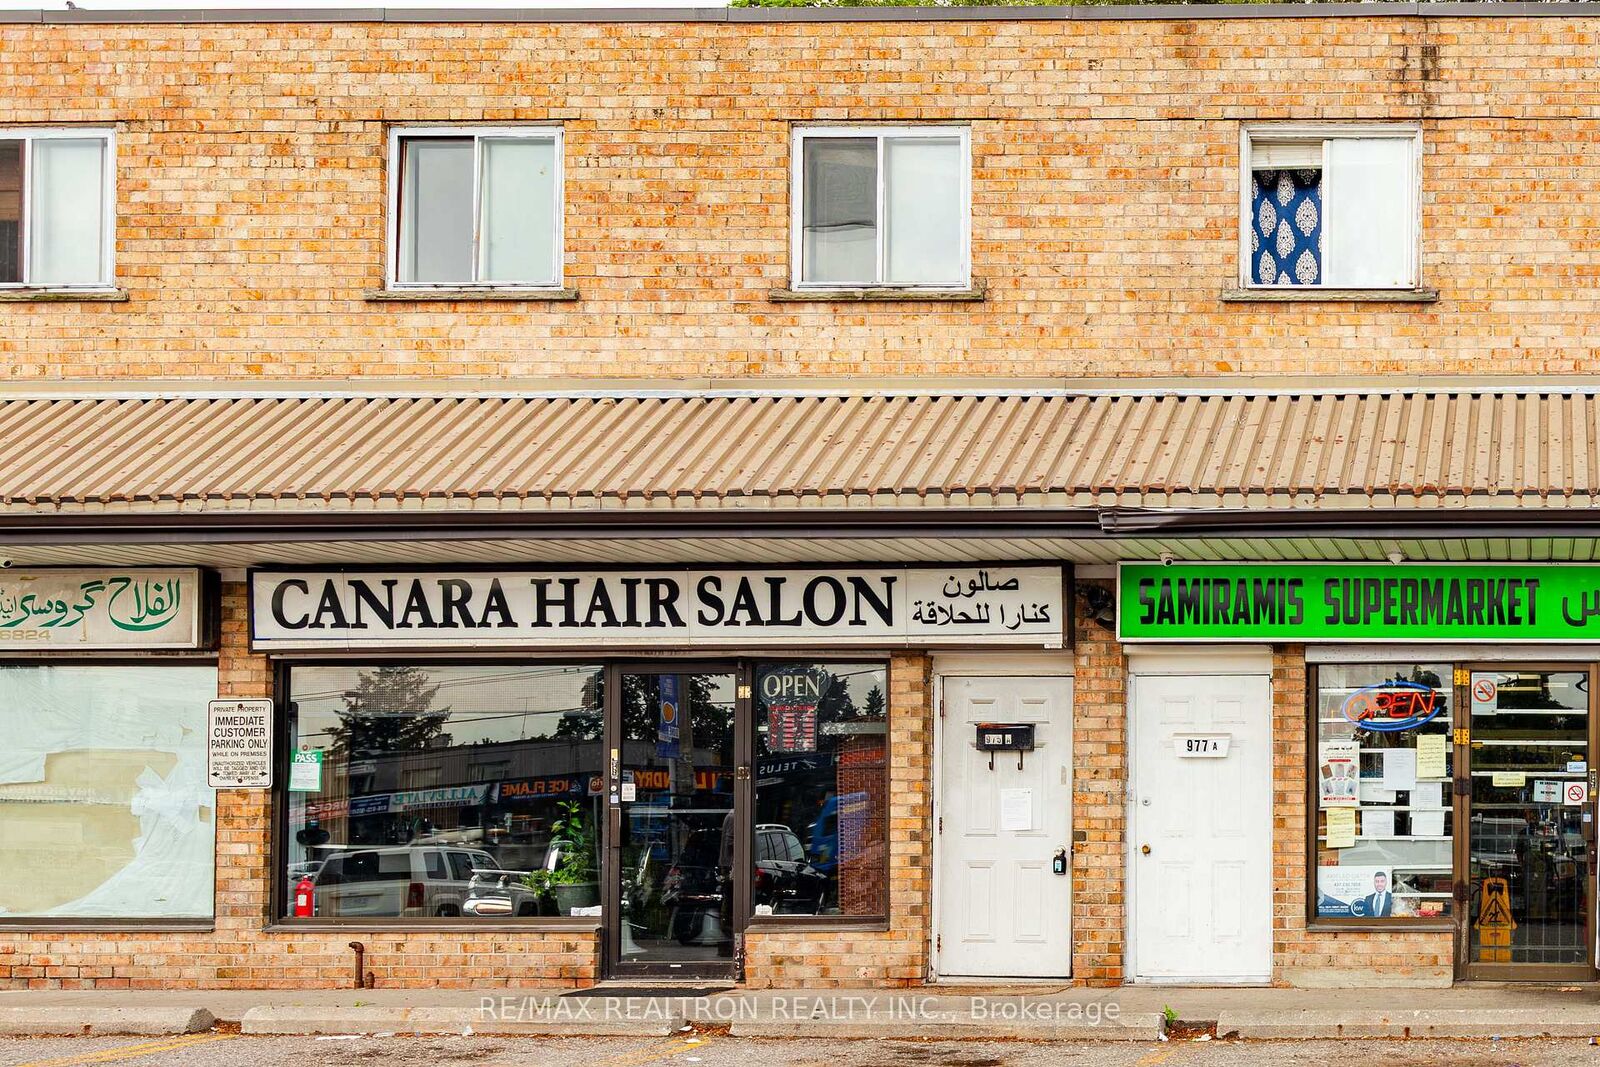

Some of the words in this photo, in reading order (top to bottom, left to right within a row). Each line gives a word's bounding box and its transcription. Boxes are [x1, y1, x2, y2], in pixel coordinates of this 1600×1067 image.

[943, 570, 1019, 598] صالون
[108, 576, 181, 631] الفلاح
[271, 578, 518, 630] CANARA
[531, 577, 687, 628] HAIR
[697, 576, 897, 627] SALON
[912, 600, 990, 626] للحلاقة
[1139, 578, 1304, 625] SAMIRAMIS
[1325, 578, 1540, 625] SUPERMARKET
[1000, 603, 1050, 631] كنارا
[763, 675, 820, 697] OPEN
[1345, 690, 1436, 720] OPEN
[214, 727, 266, 737] CUSTOMER
[215, 716, 264, 726] IMMEDIATE
[211, 739, 245, 748] PARKING
[248, 739, 268, 748] ONLY
[1186, 739, 1208, 752] 977
[1212, 741, 1218, 751] A
[295, 754, 317, 763] PASS
[1353, 904, 1364, 912] kw
